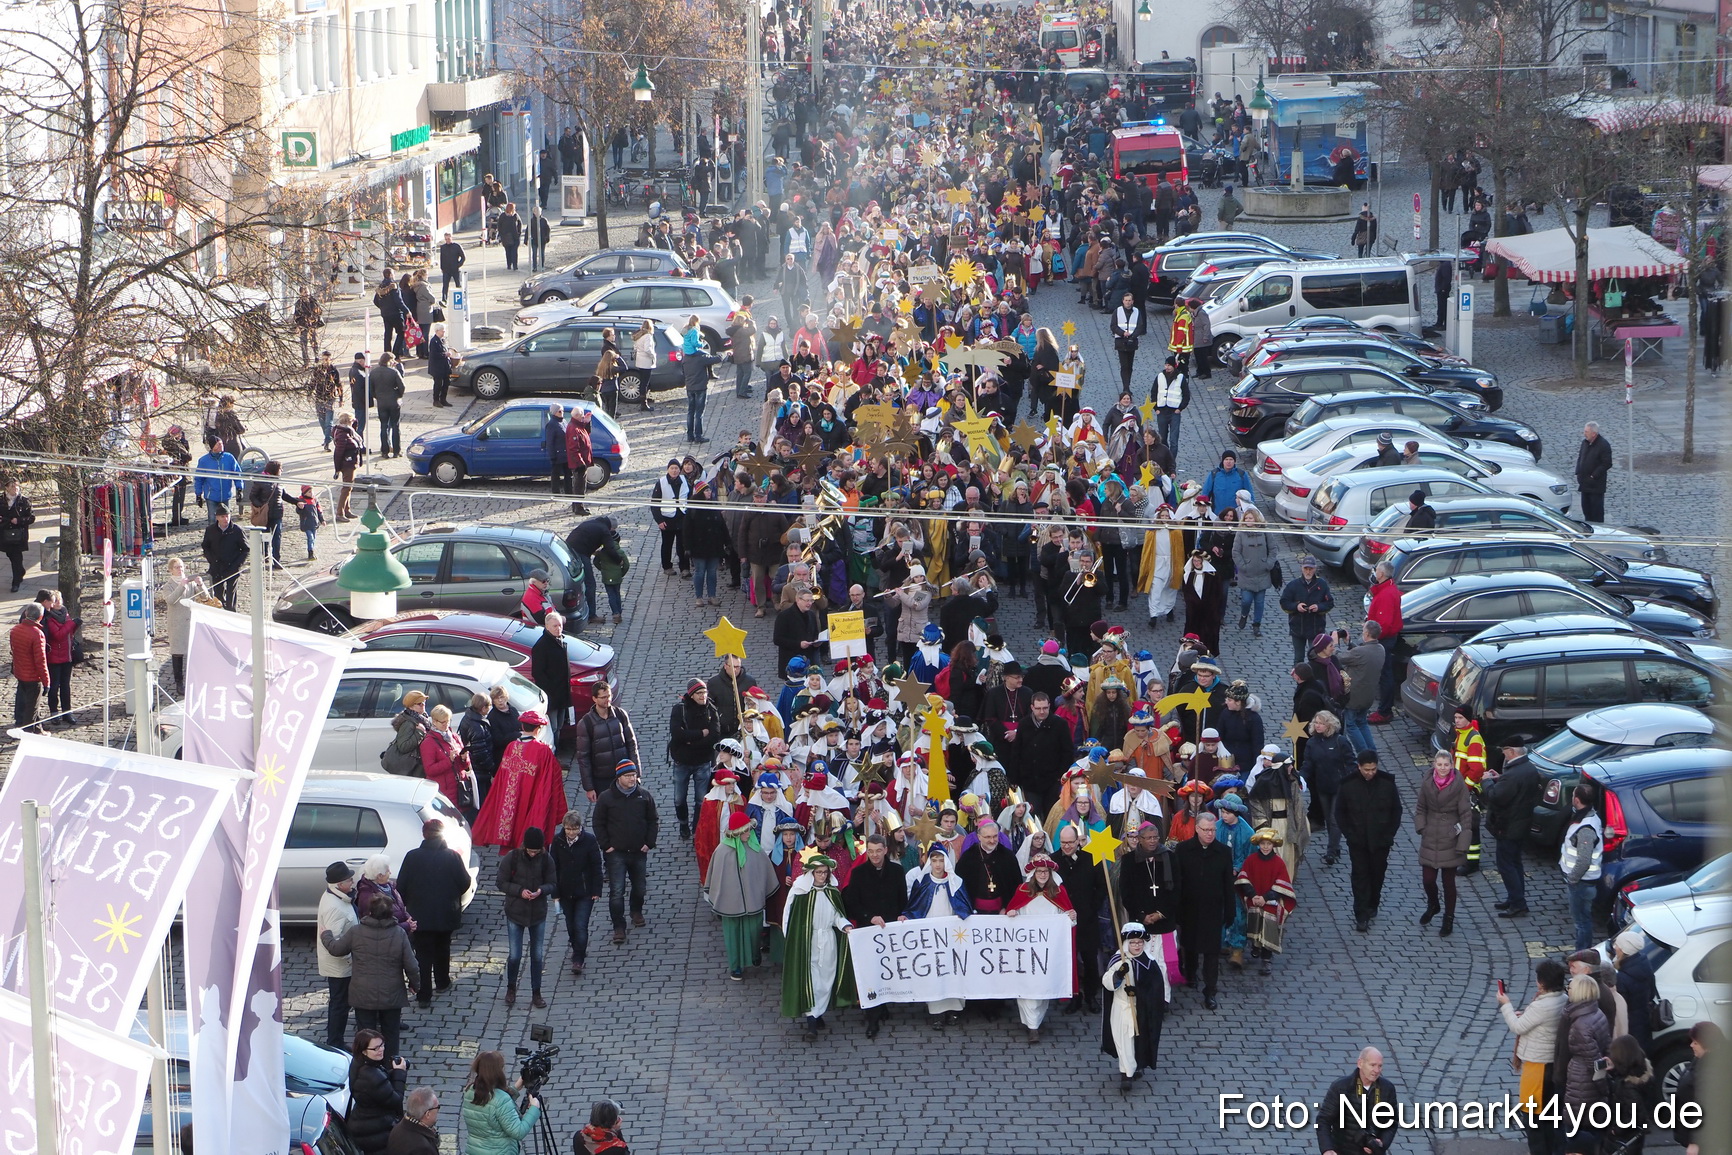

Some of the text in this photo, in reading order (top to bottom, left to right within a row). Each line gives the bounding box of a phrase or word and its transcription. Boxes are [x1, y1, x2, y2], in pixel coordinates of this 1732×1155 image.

[288, 137, 313, 162] D
[455, 294, 461, 302] P
[1463, 295, 1469, 303] P
[130, 593, 140, 607] P
[872, 927, 1049, 954] SEGEN BRINGEN
[880, 947, 1049, 980] SEGEN SEIN
